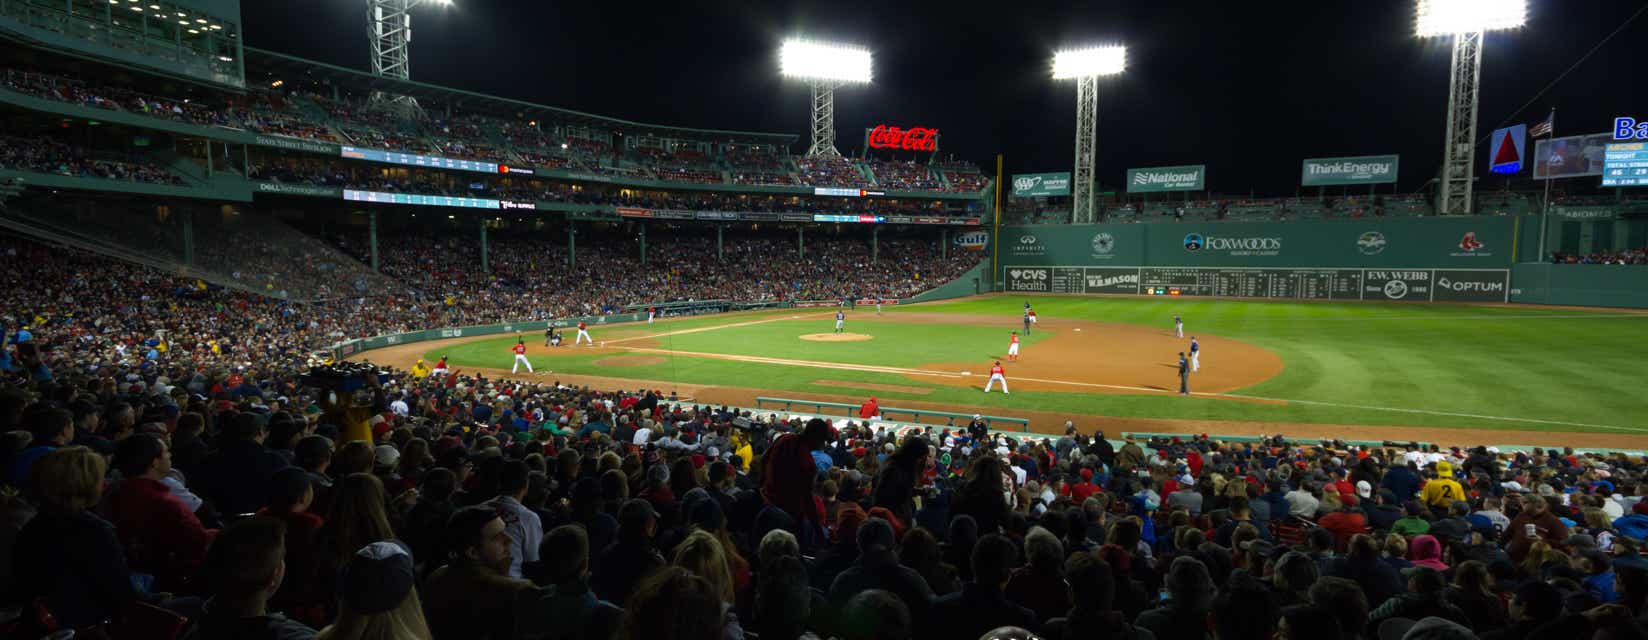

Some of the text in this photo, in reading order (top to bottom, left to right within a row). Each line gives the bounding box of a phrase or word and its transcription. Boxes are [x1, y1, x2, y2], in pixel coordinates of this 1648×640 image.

[869, 124, 938, 151] Coca-Cola
[1309, 162, 1389, 174] ThinkEnergy
[1148, 171, 1198, 184] National
[260, 183, 281, 192] DELL
[956, 234, 985, 245] Gulf
[1205, 236, 1281, 250] FOXWOODS
[1022, 269, 1047, 280] CVS
[1391, 271, 1428, 280] WEBB
[1012, 280, 1047, 291] Health
[1452, 281, 1503, 291] OPTUM
[1441, 484, 1453, 498] 2
